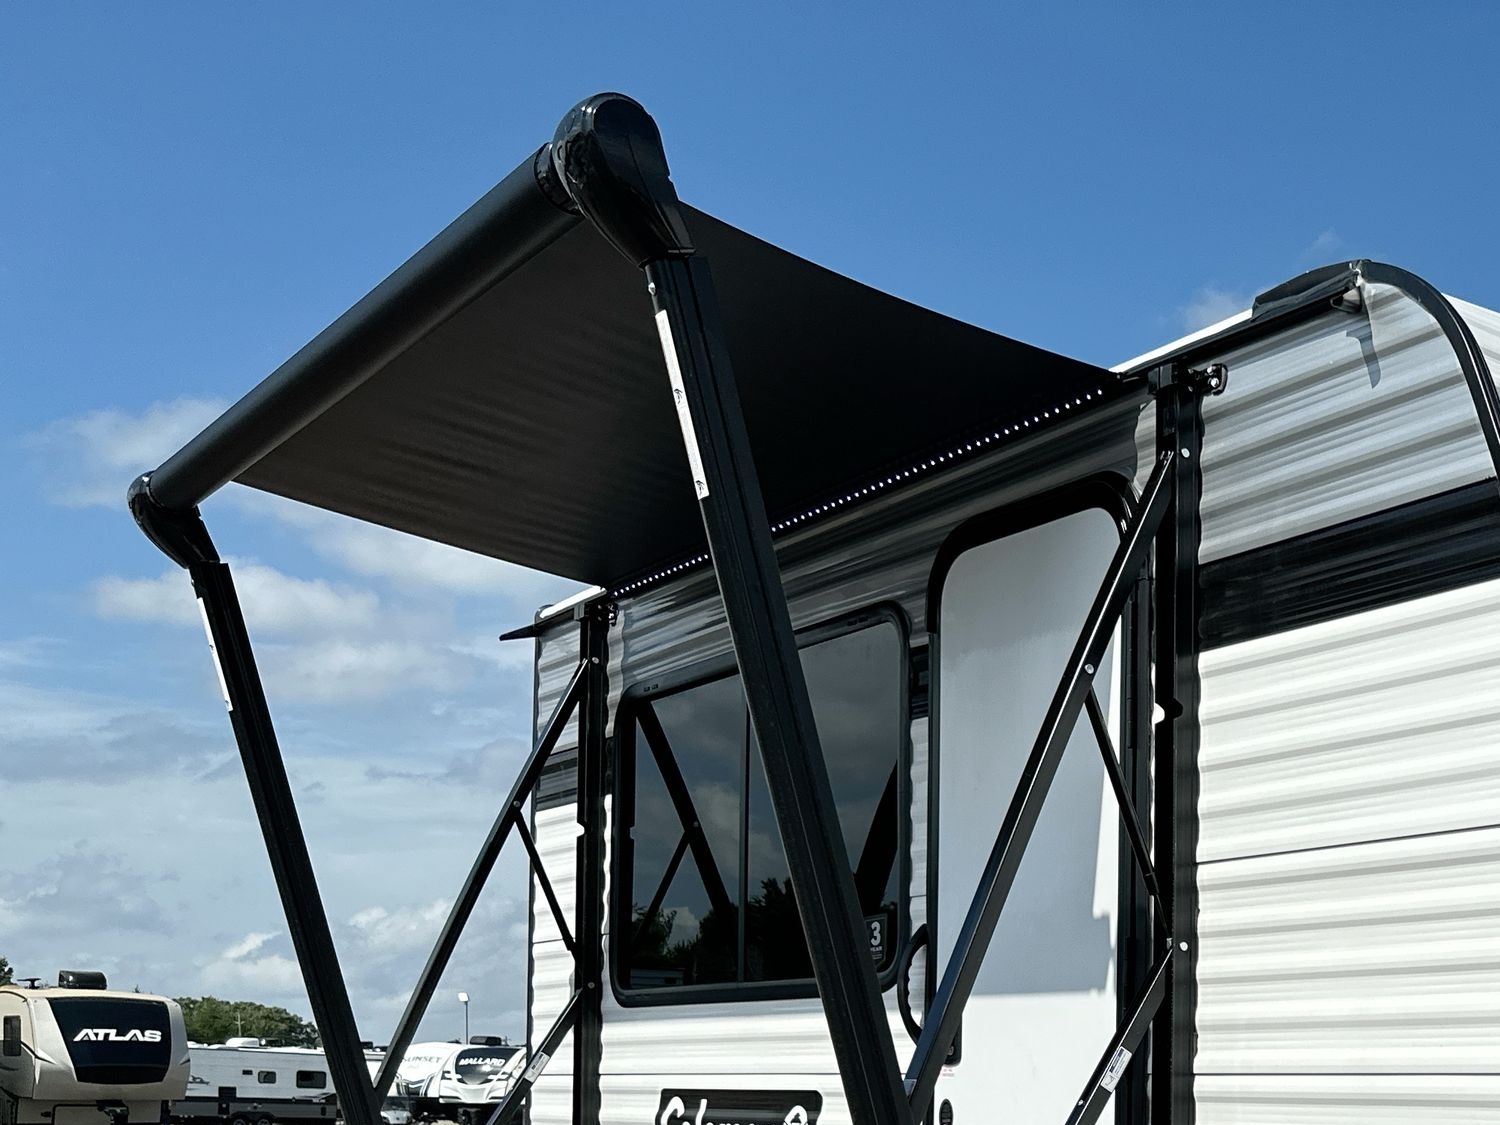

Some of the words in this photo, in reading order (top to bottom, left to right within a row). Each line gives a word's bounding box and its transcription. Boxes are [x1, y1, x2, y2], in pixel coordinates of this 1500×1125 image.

[870, 921, 881, 946] 3
[73, 1028, 162, 1043] ATLAS
[459, 1057, 506, 1067] MALLARD
